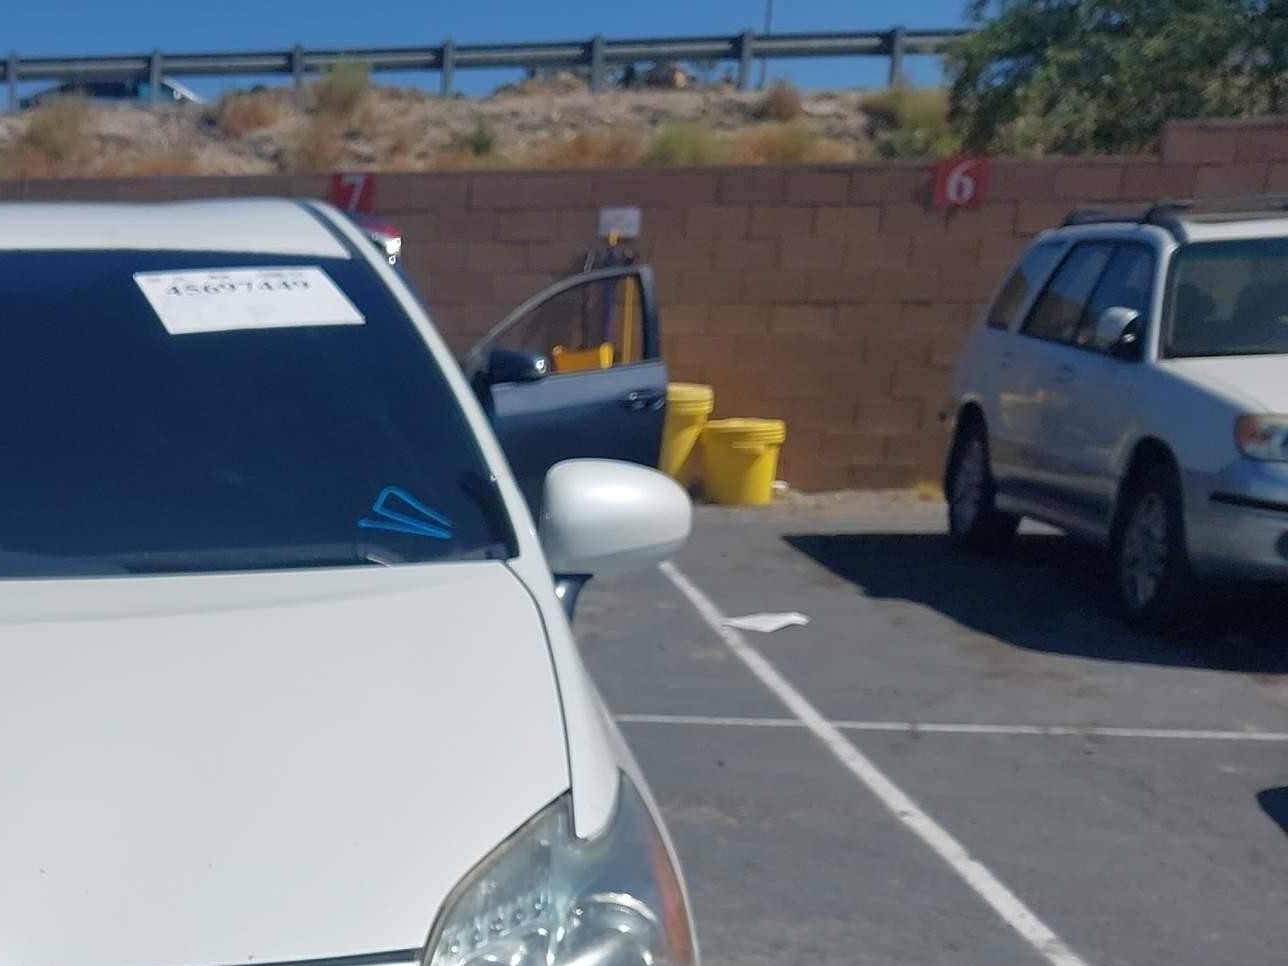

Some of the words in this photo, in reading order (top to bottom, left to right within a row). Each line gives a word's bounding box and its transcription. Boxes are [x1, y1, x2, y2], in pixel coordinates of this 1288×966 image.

[341, 172, 367, 213] 7
[946, 160, 975, 203] 6
[166, 279, 311, 297] 45697449
